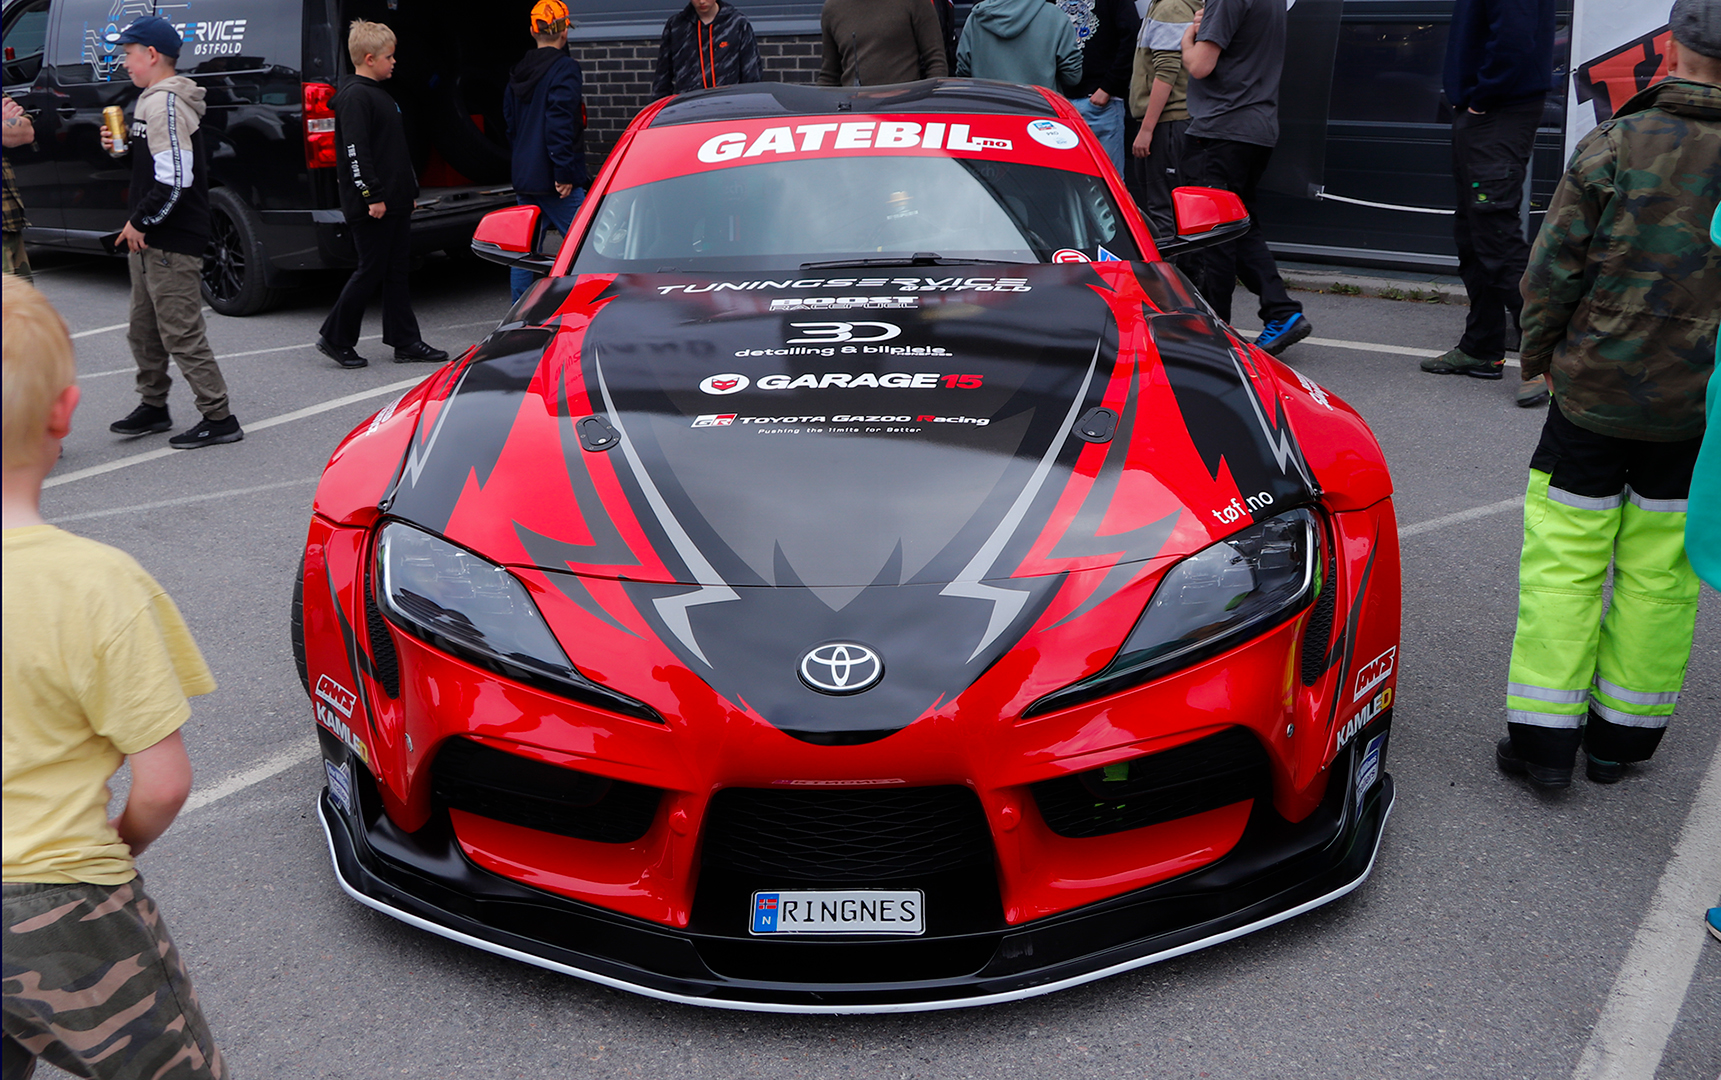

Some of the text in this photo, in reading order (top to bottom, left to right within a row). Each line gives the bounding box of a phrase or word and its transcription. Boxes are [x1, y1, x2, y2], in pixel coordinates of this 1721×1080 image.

[170, 19, 247, 42] SERVICE
[194, 42, 242, 55] ØSTFOLD
[656, 277, 1029, 295] TUNINGSERVICE
[734, 346, 835, 357] detailing
[840, 345, 858, 354] &
[740, 416, 827, 425] TOYOTA
[831, 414, 912, 422] GAZOO
[916, 414, 991, 426] Racing
[1211, 491, 1274, 525] tøf.no
[1336, 687, 1393, 752] KAMLED
[316, 701, 368, 764] KAMLED
[761, 915, 772, 925] N
[782, 899, 916, 923] RINGNES
